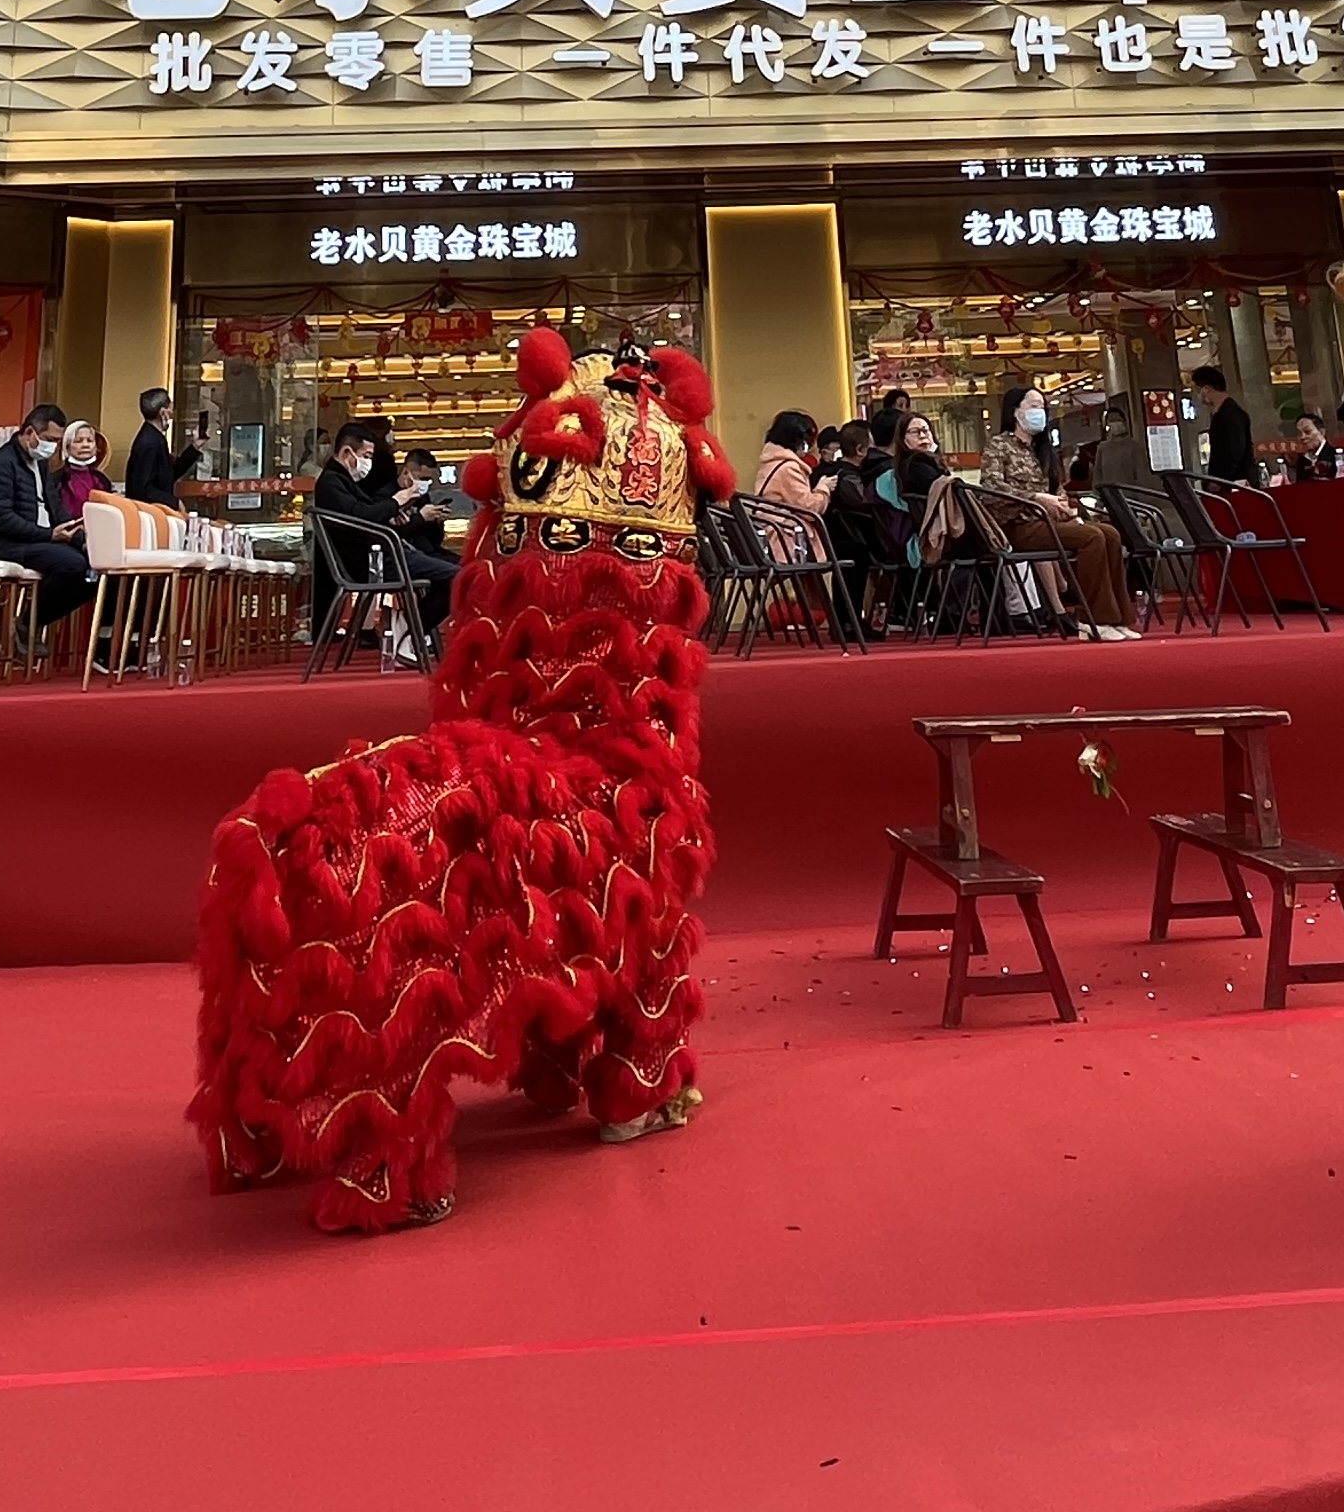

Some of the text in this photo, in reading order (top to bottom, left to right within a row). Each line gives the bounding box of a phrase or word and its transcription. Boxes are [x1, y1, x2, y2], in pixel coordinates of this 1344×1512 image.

[149, 28, 475, 95] 批发零售
[552, 20, 870, 85] 一件代发
[309, 221, 579, 266] 老水贝黄金珠宝城
[962, 204, 1216, 246] 老水贝黄金珠宝城
